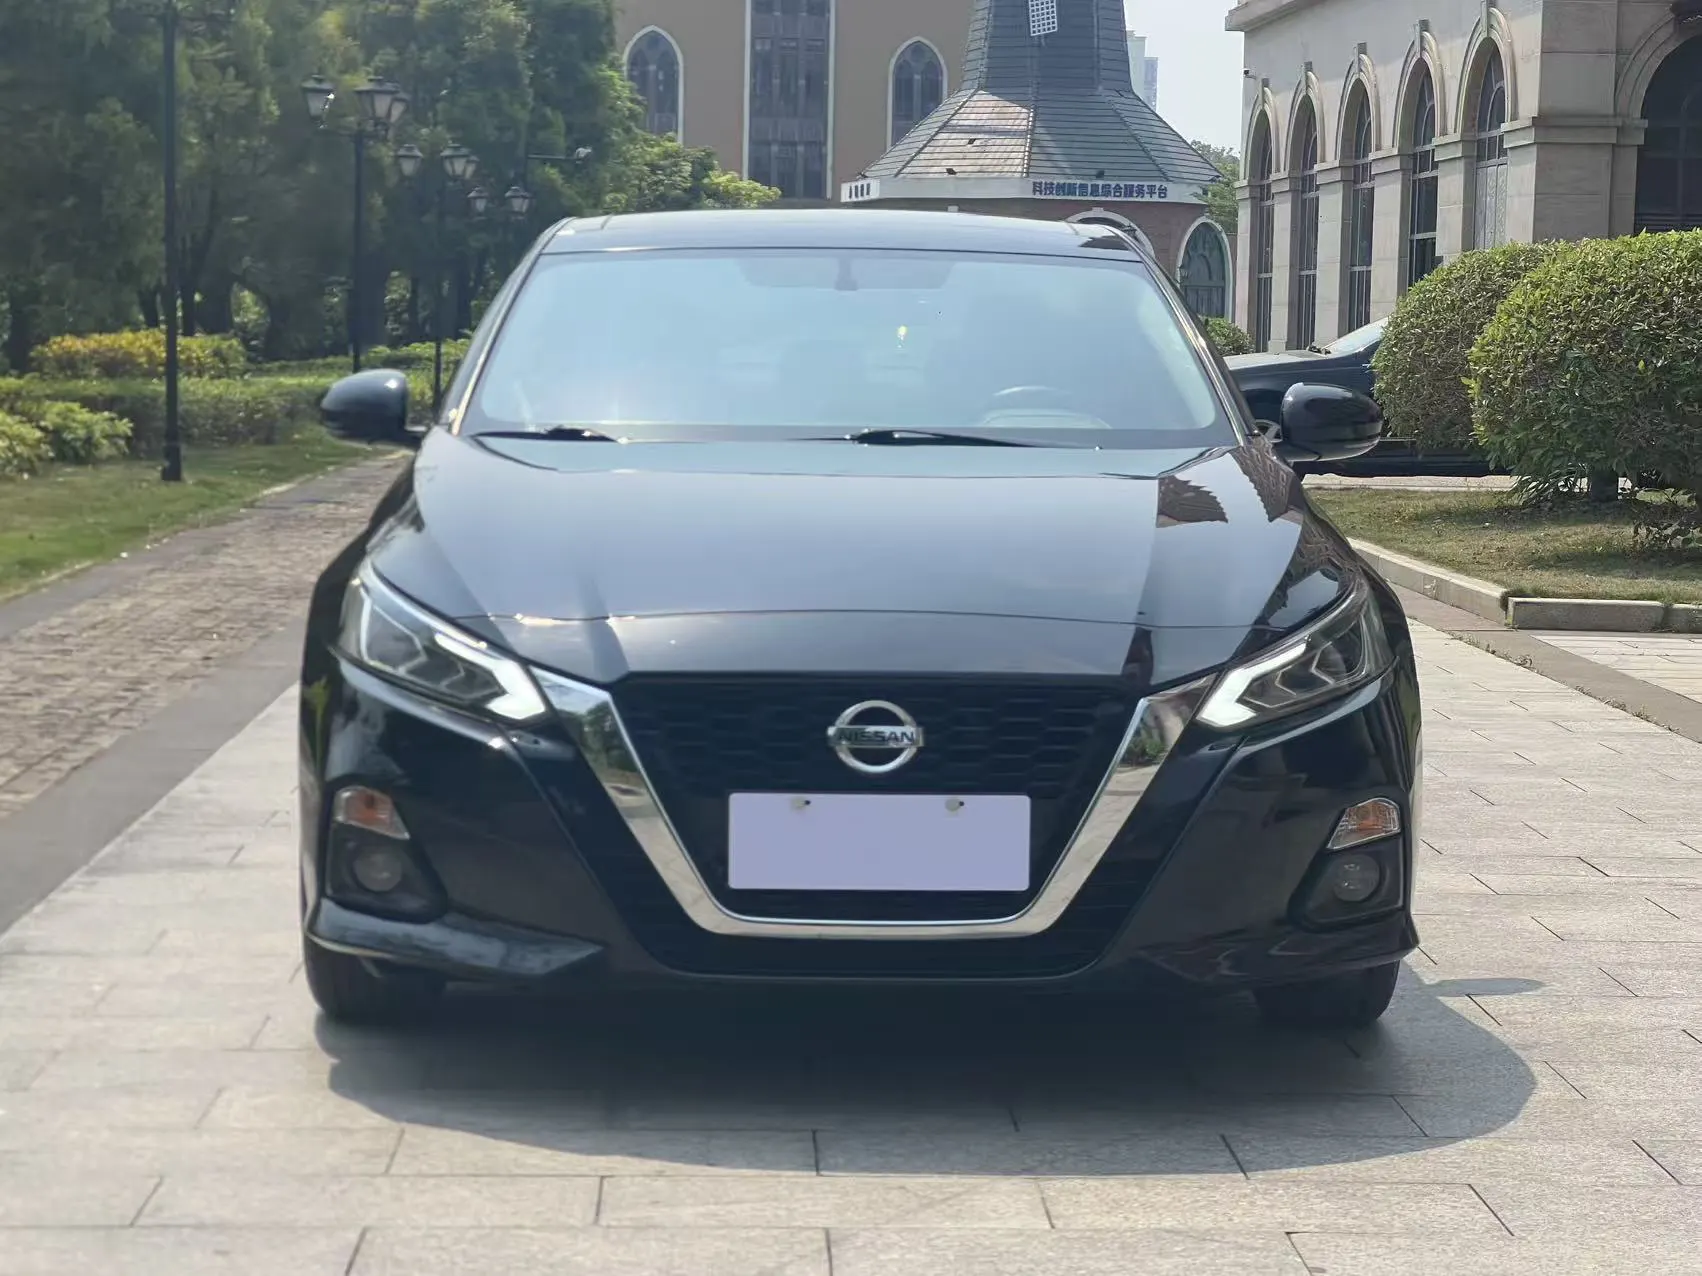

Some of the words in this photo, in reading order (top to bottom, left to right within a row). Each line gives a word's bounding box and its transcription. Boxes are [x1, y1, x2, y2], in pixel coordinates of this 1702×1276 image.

[1032, 181, 1168, 199] 科技创新信息综合服务平台
[837, 730, 915, 743] NISSAN
